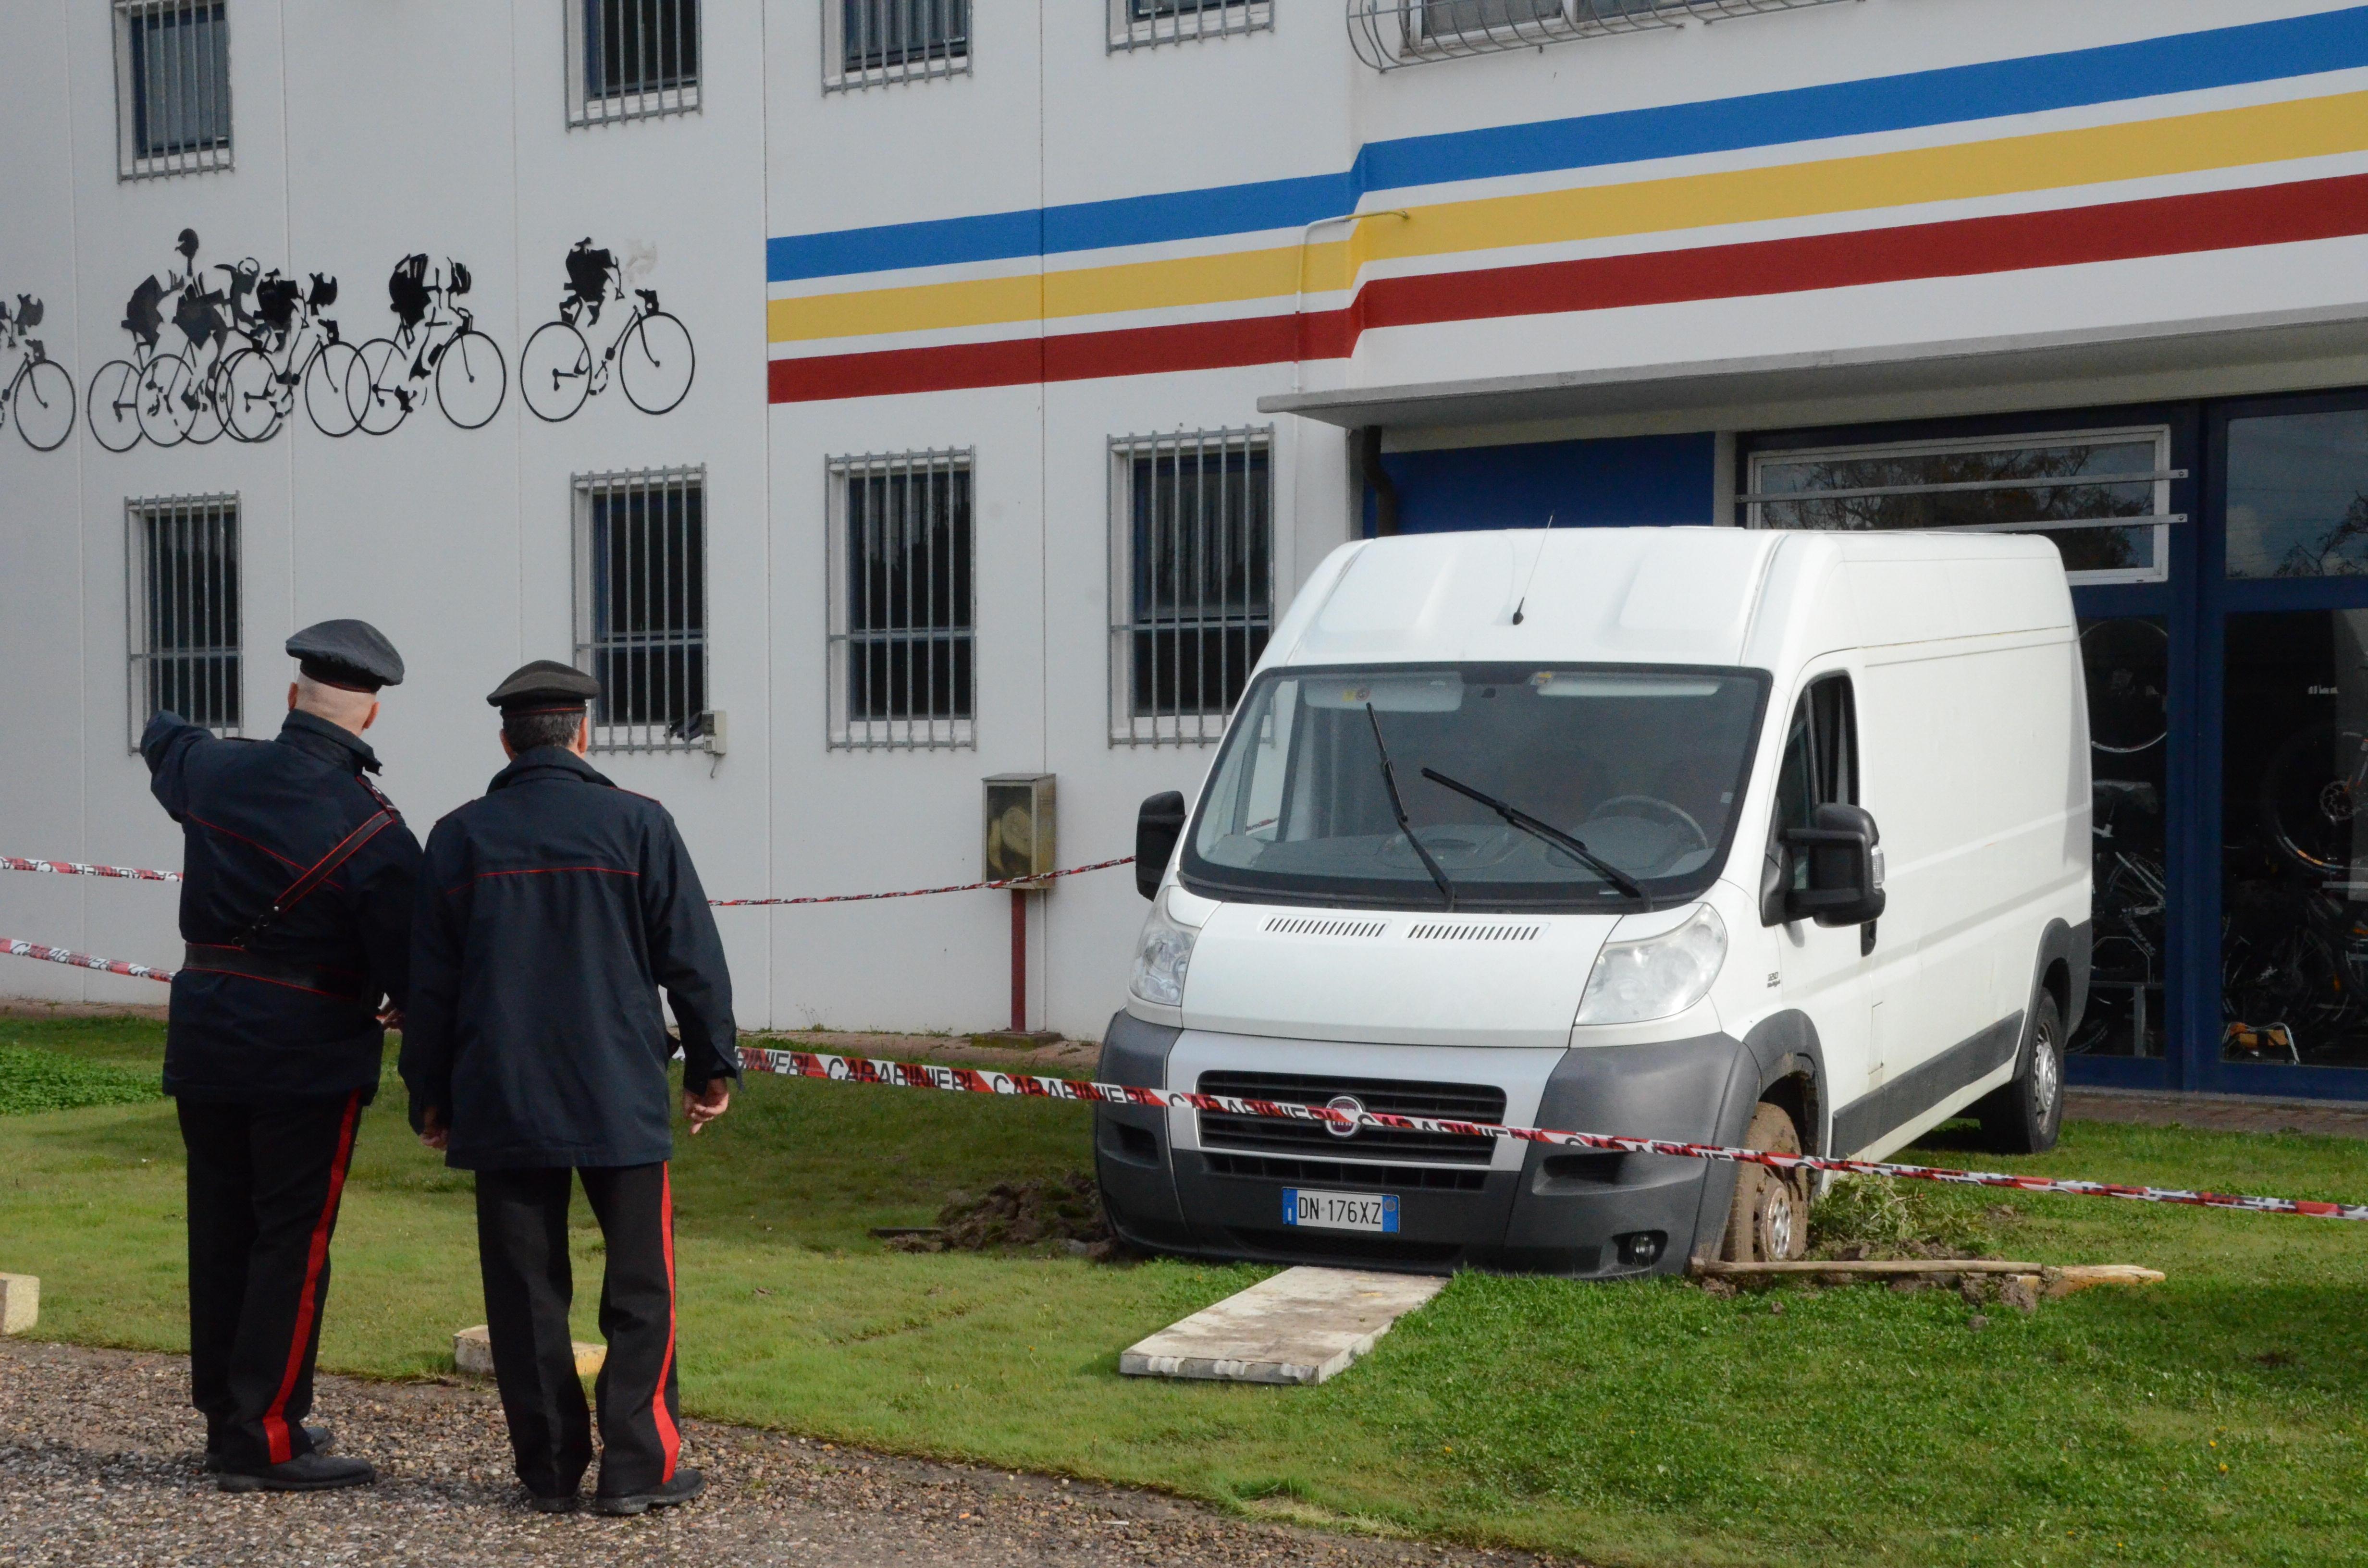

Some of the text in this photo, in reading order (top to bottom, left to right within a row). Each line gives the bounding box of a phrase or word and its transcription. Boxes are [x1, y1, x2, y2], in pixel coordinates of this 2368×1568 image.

[828, 1057, 974, 1091] CARABINIERI
[993, 1075, 1148, 1104] CARABINIERI
[1298, 1197, 1381, 1225] DN 176XZ
